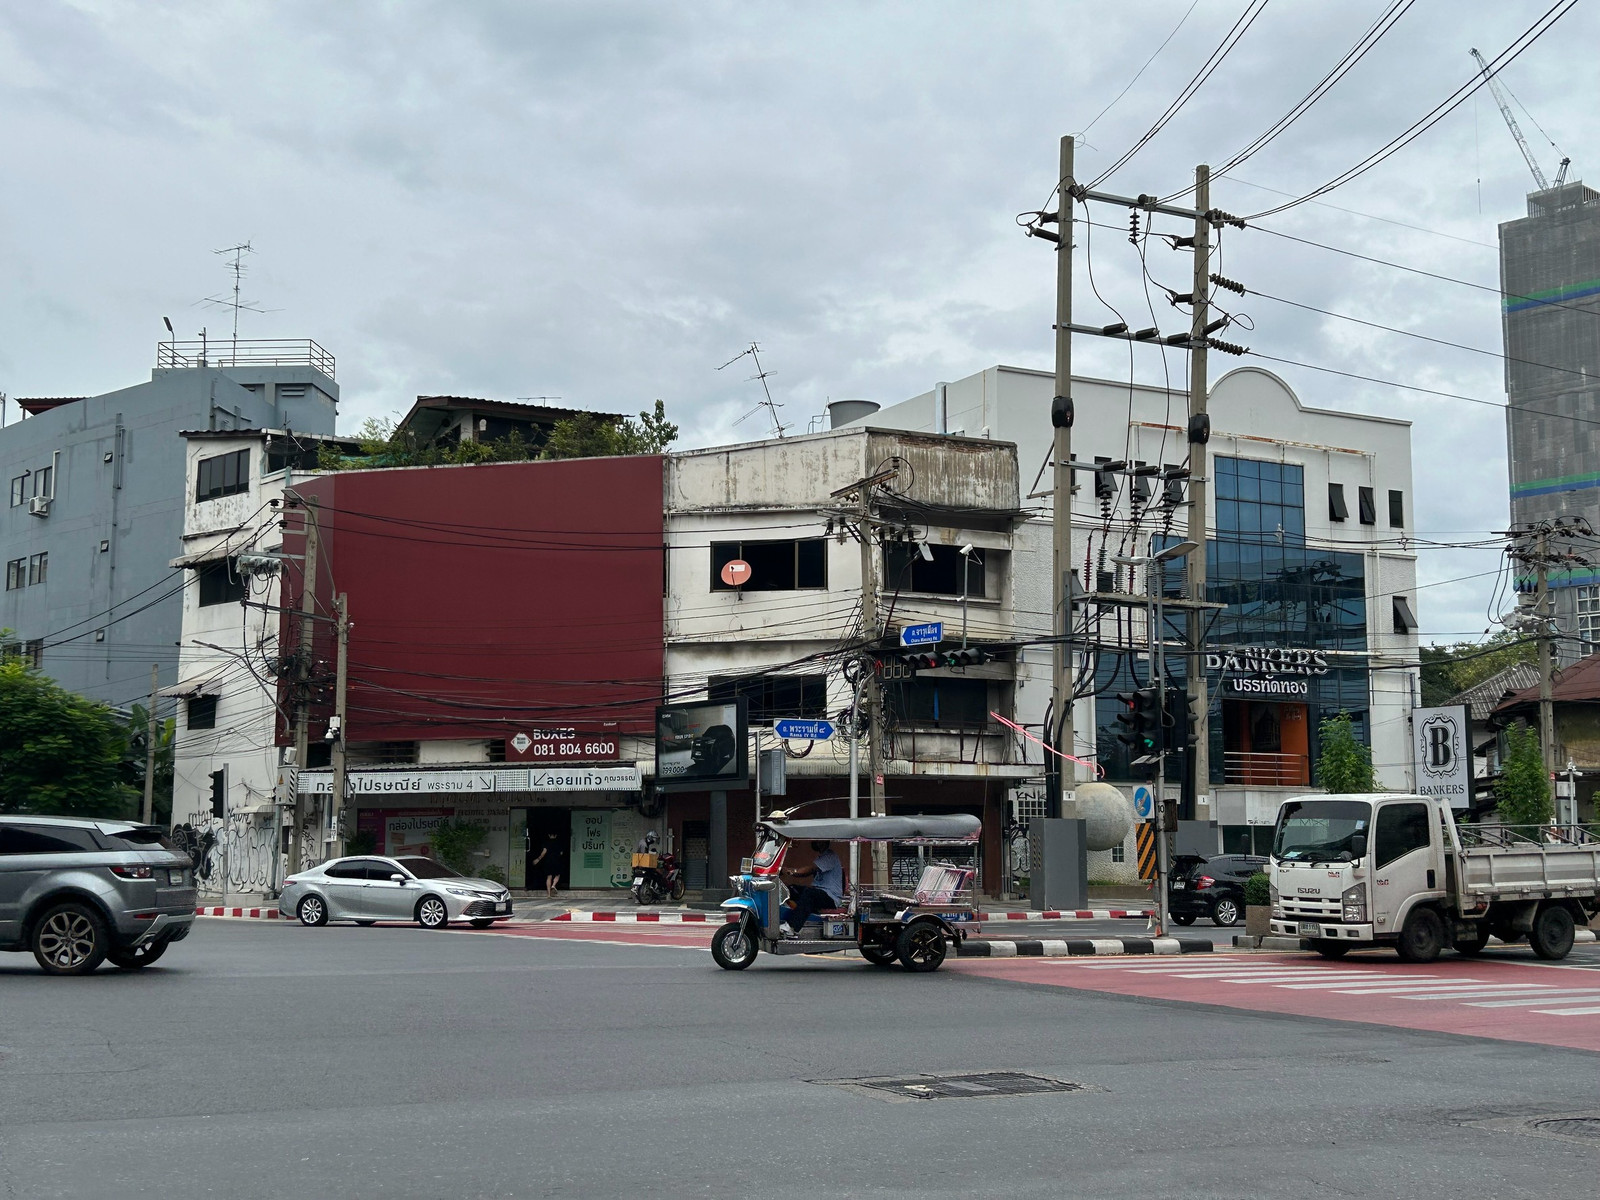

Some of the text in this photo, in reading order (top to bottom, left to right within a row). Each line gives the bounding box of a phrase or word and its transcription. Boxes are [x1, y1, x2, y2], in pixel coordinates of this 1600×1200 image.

[1206, 647, 1329, 676] BANKERS
[1232, 674, 1308, 694] บรรทัดทอง
[533, 727, 576, 741] BOXES
[533, 742, 615, 756] 081 804 6600
[1429, 725, 1451, 768] B
[427, 781, 463, 790] พระราม
[466, 780, 473, 790] 4
[546, 772, 602, 786] ลอยแก้ว
[1420, 784, 1465, 796] BANKERS
[1157, 804, 1165, 813] 10
[1297, 887, 1321, 895] ISUZU
